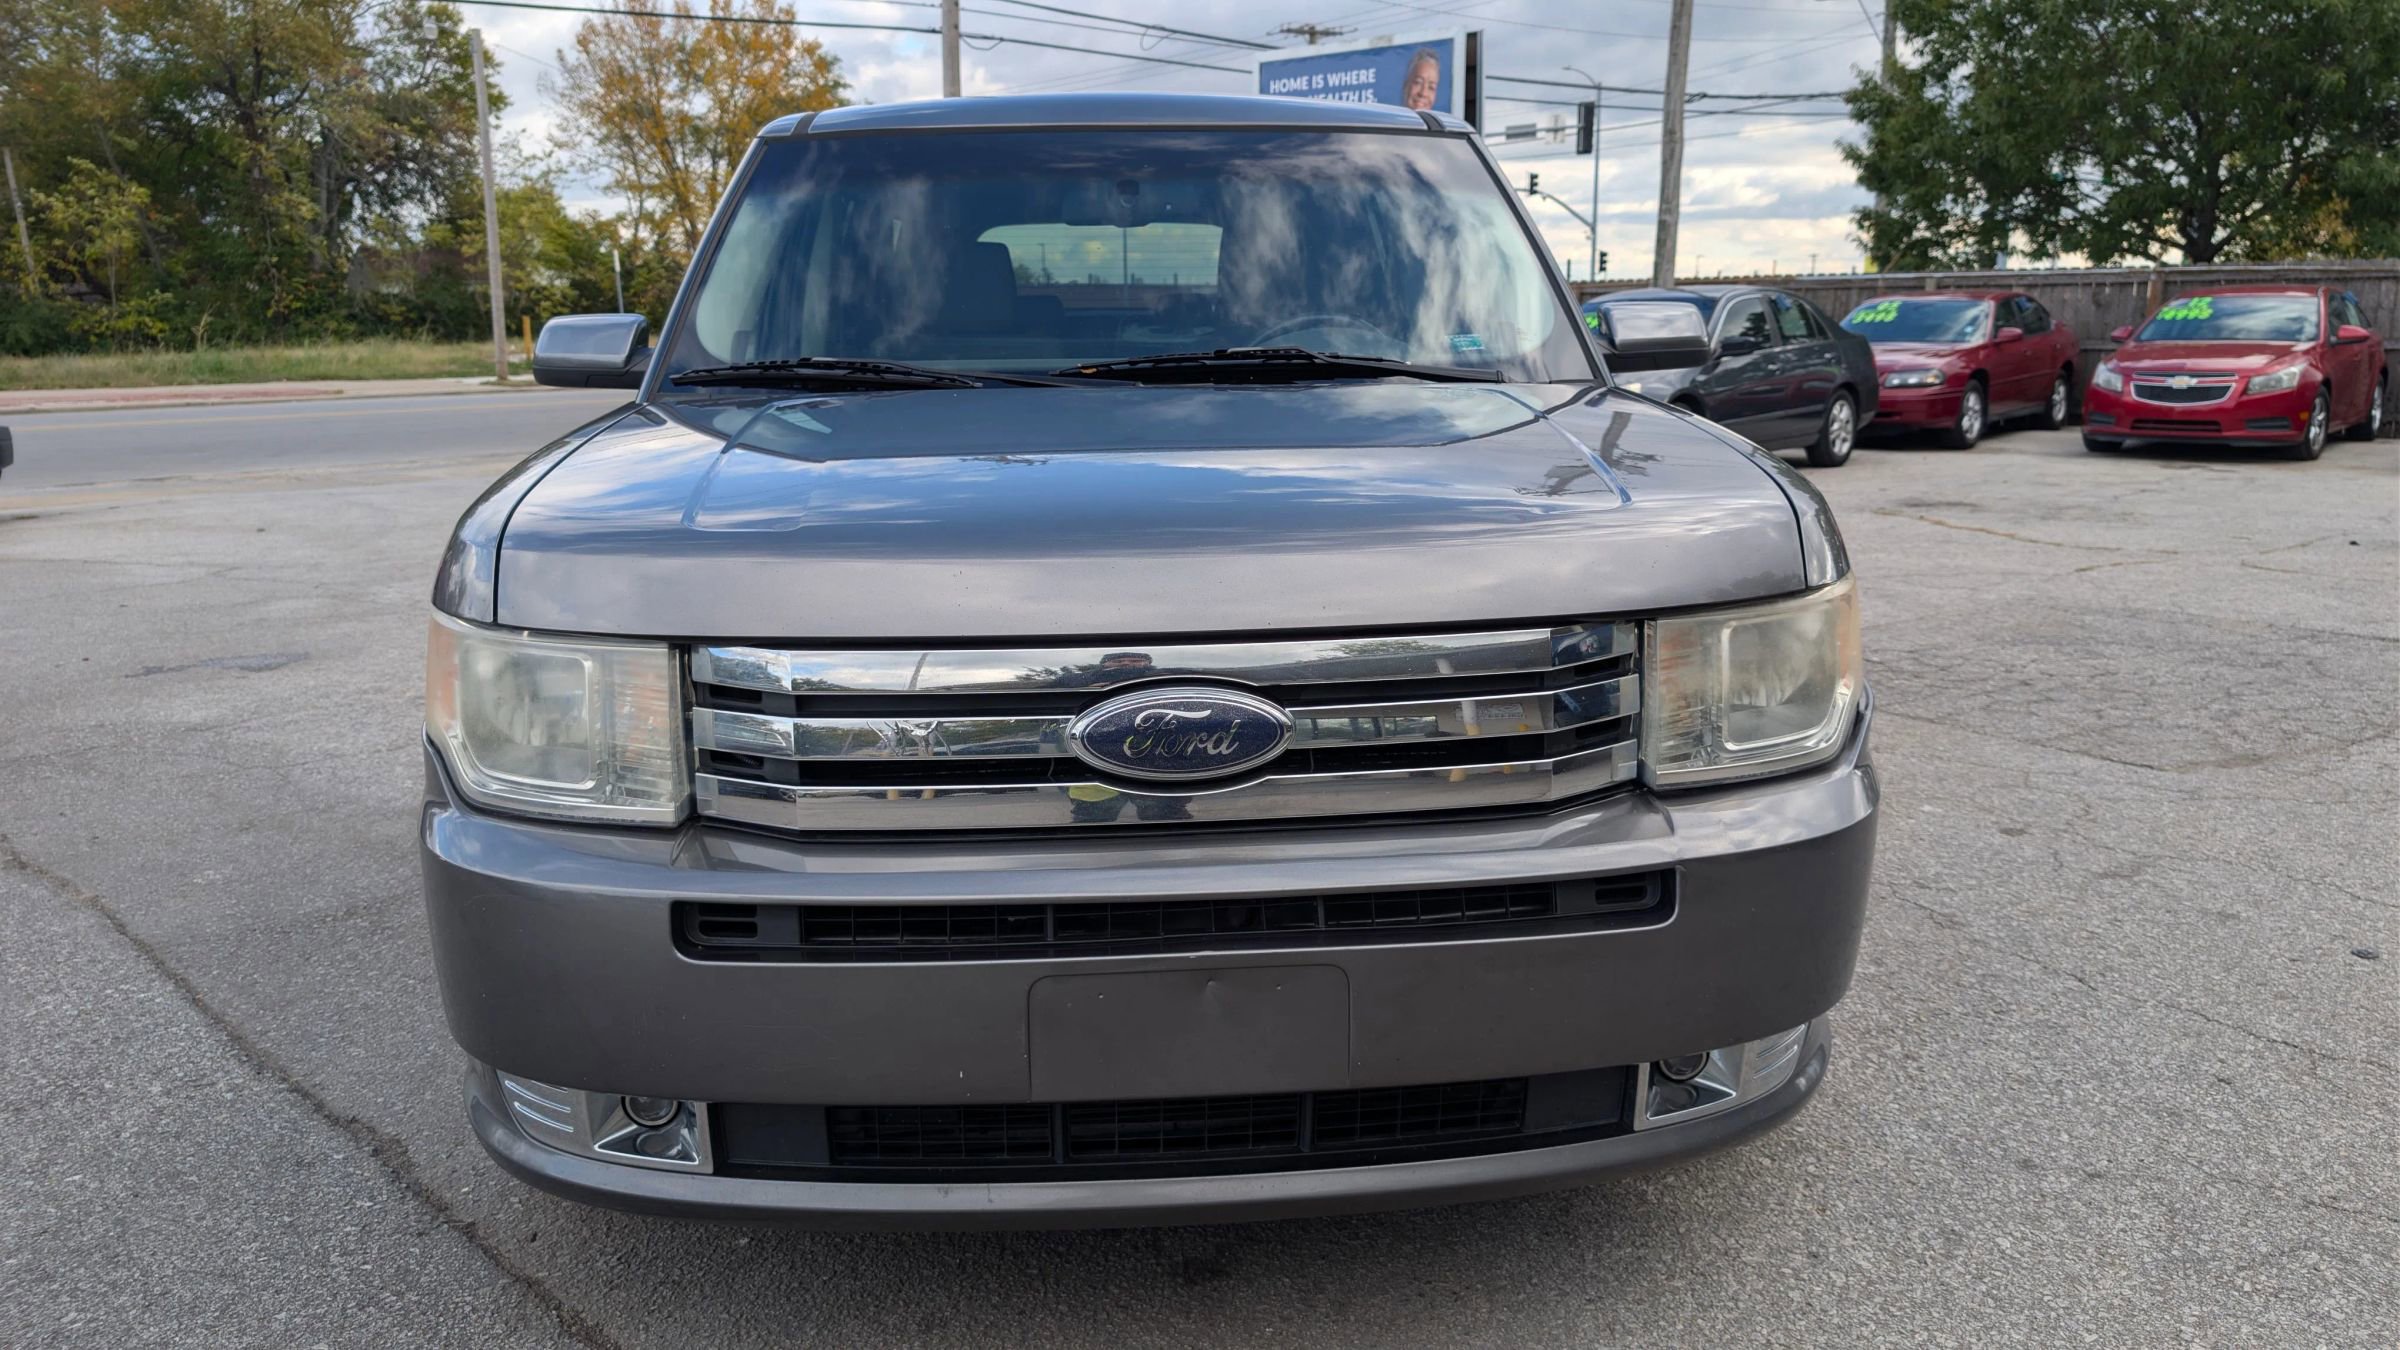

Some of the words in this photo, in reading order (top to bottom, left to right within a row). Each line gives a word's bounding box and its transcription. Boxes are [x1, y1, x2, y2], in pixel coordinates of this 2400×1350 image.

[1269, 75, 1310, 94] HOME
[1312, 73, 1325, 89] IS
[1327, 67, 1377, 86] WHERE
[1123, 708, 1242, 758] Ford
